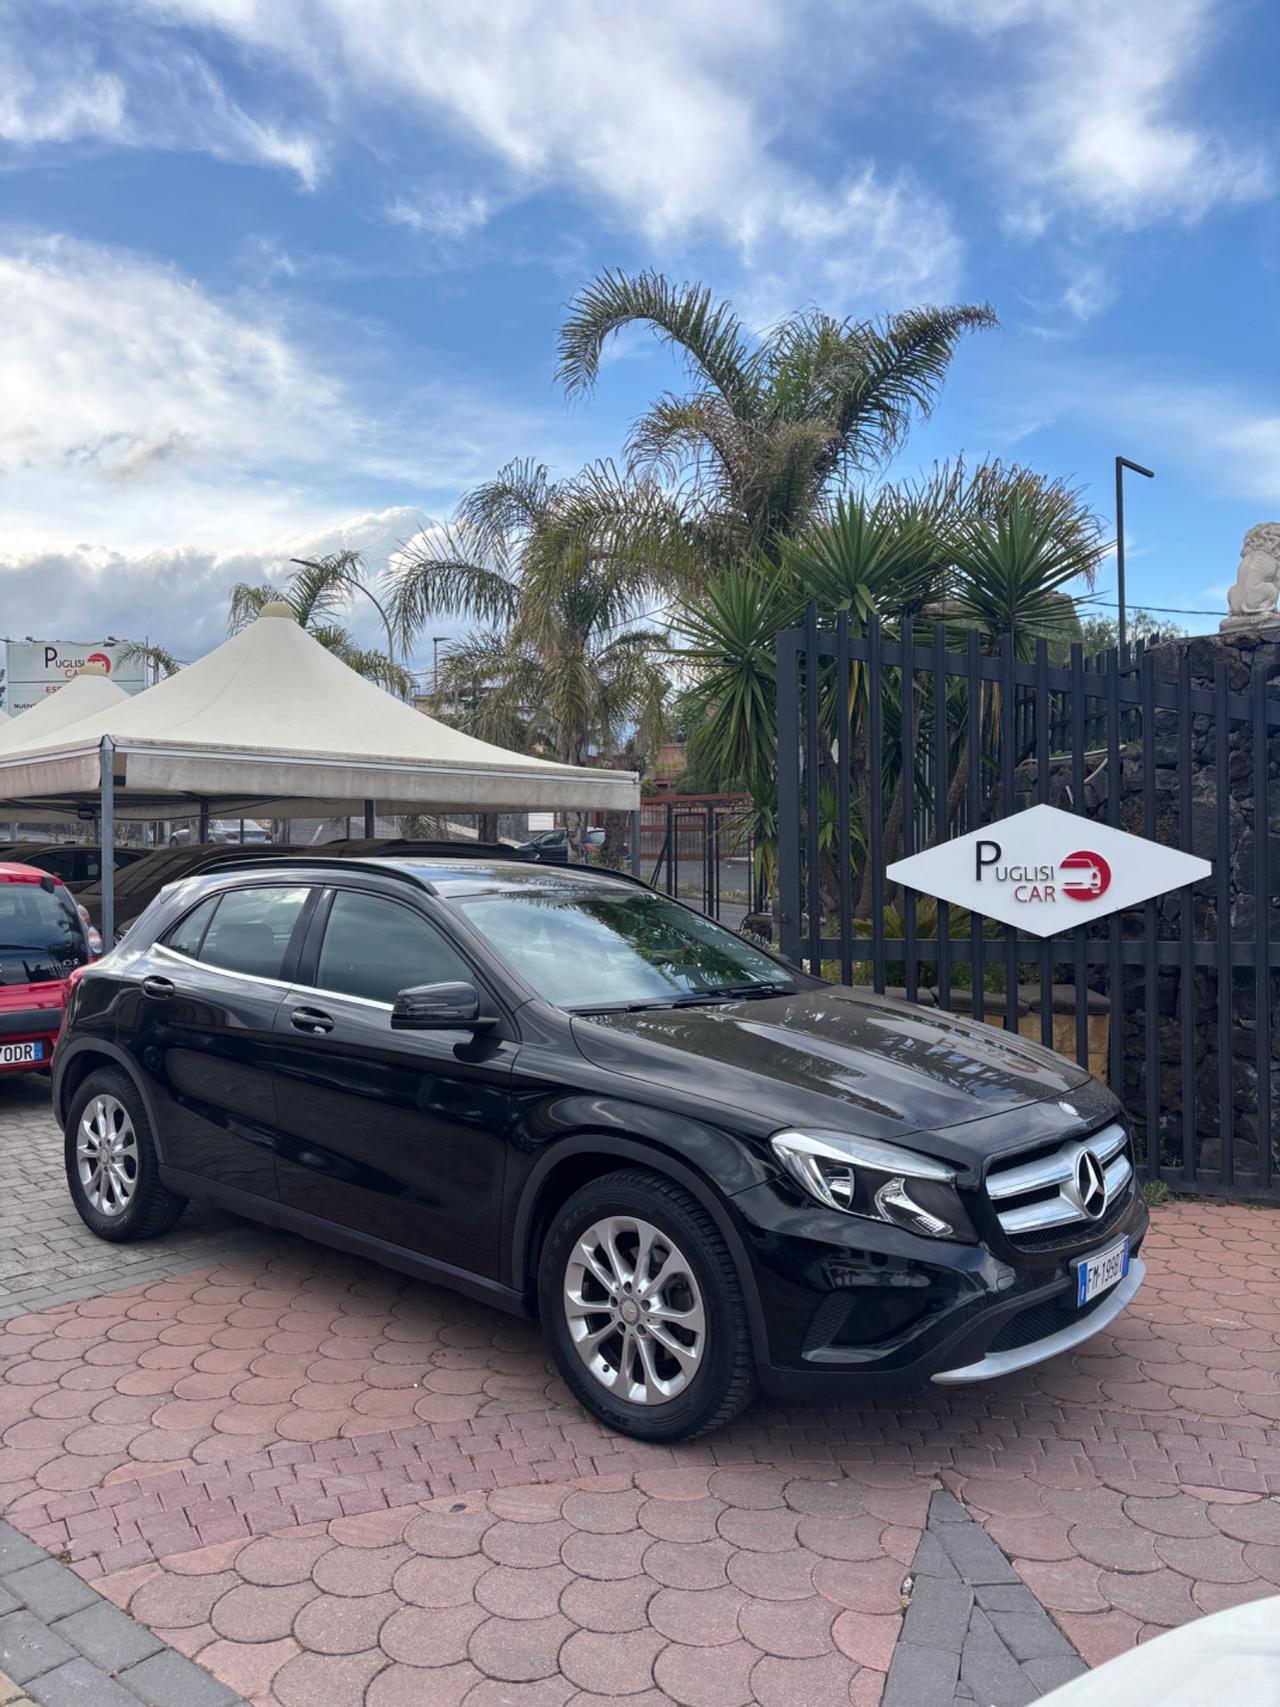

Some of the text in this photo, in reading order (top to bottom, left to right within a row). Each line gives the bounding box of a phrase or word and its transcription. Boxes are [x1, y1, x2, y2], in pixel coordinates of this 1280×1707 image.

[975, 840, 1055, 882] PUGLISI
[1014, 885, 1057, 903] CAR
[0, 1044, 33, 1062] 0DR
